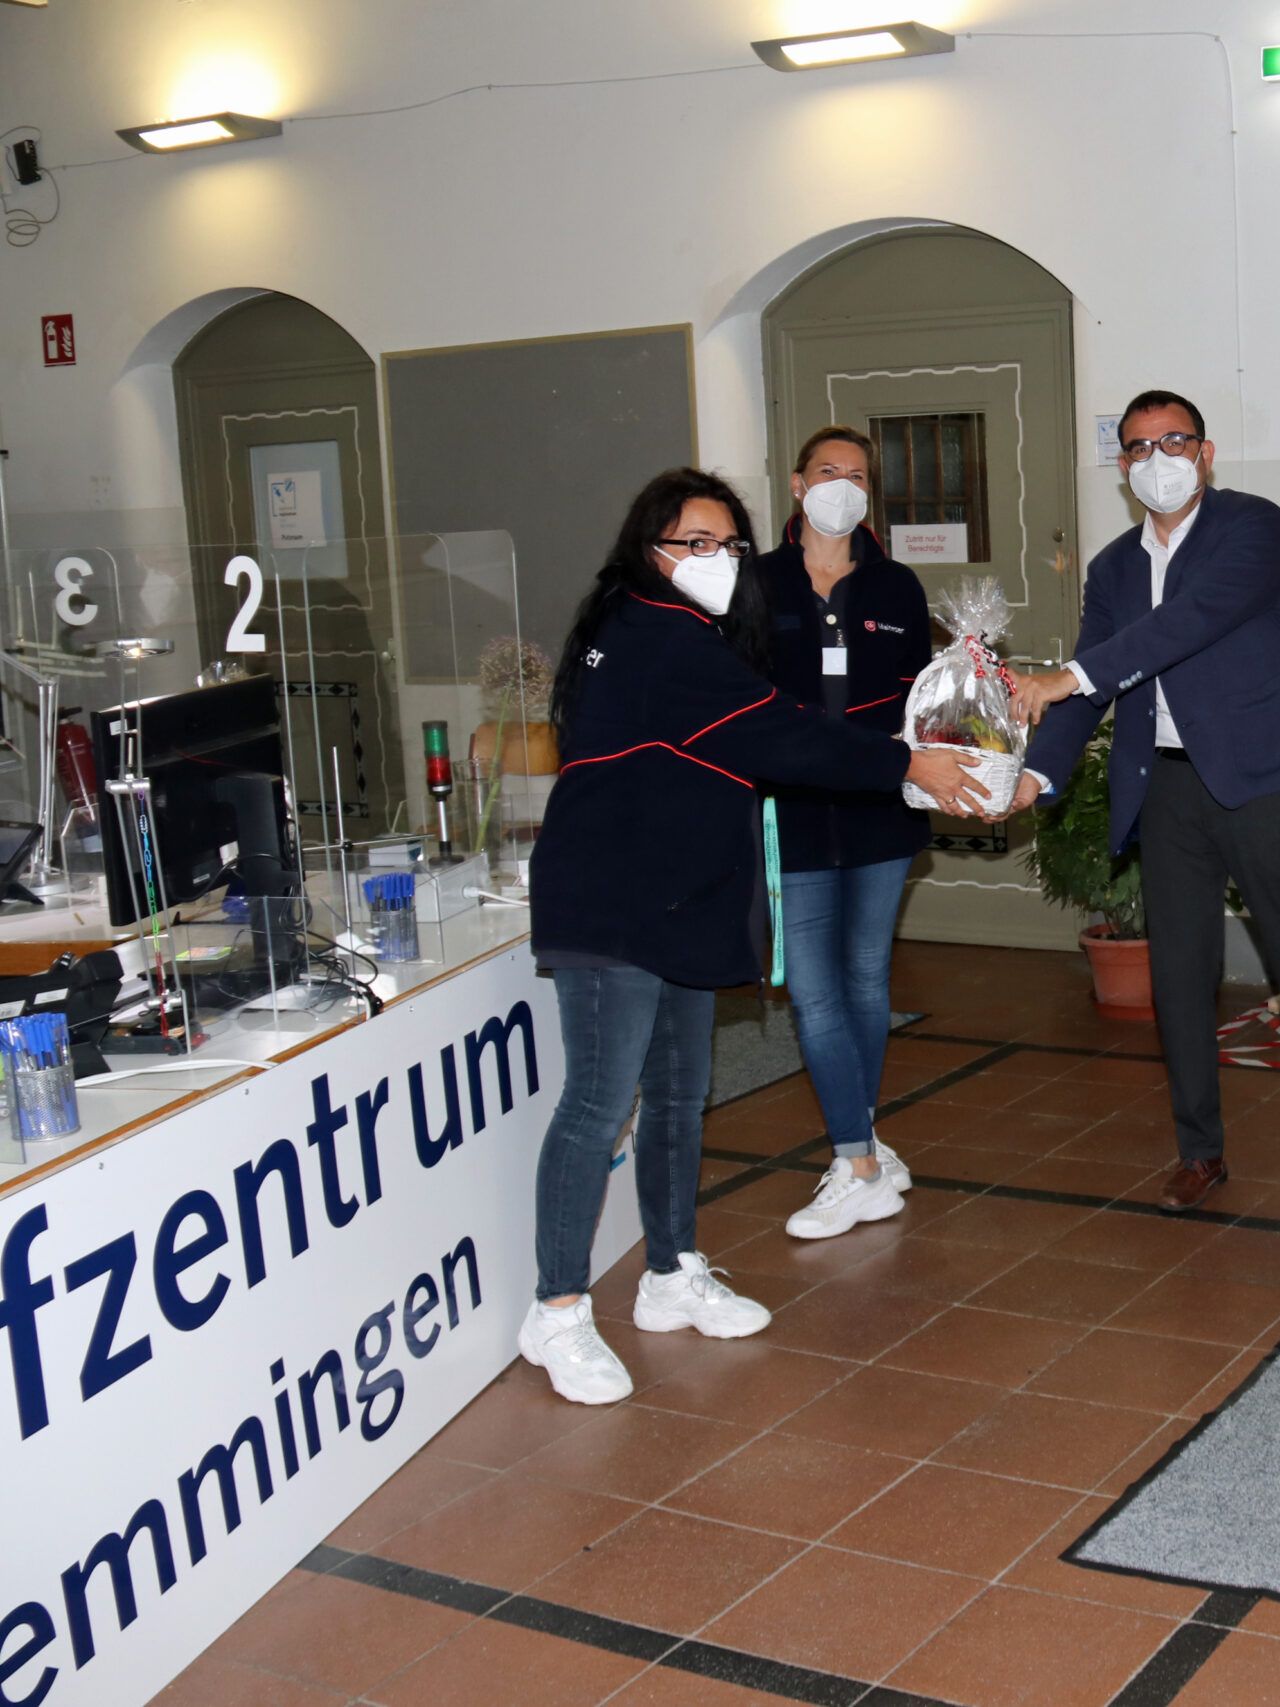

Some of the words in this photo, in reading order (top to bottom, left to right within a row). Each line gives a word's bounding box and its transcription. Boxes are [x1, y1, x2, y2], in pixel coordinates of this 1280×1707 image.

[224, 555, 266, 652] 2
[0, 1000, 540, 1441] fzentrum
[0, 1236, 482, 1707] emmingen
